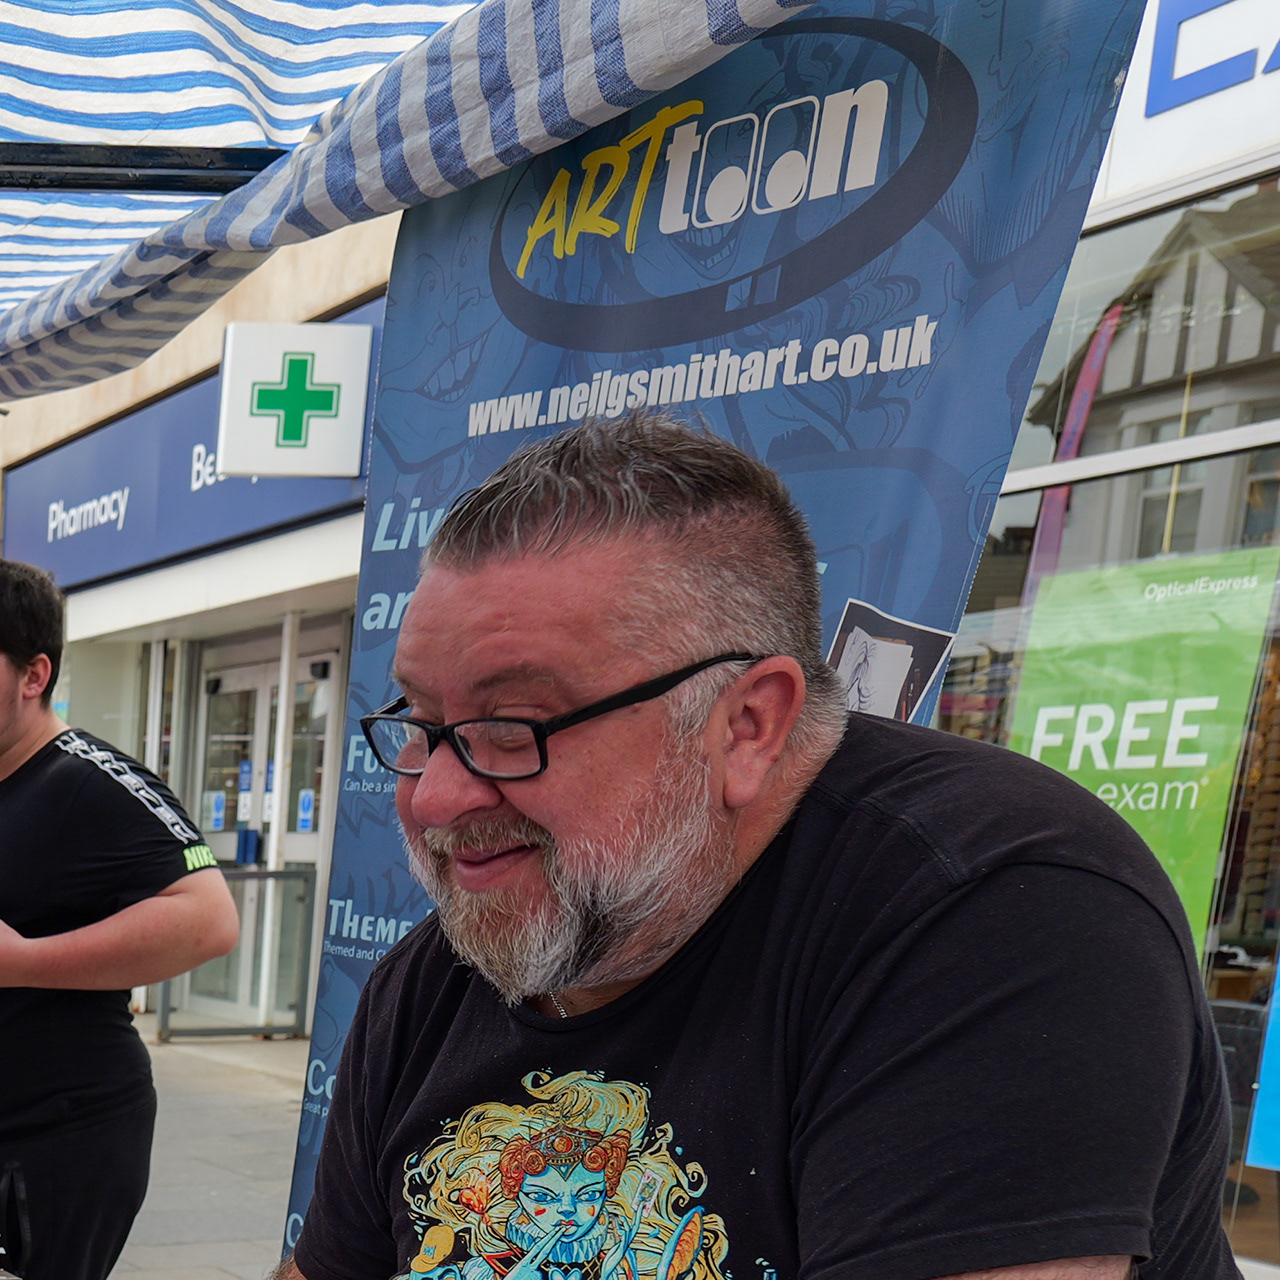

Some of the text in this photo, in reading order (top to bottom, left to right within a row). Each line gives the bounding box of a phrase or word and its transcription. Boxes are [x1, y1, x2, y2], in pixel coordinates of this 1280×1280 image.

[466, 314, 941, 438] www.neilgsmithart.co.uk
[47, 486, 130, 543] Pharmacy
[371, 497, 445, 552] Liv
[1030, 696, 1219, 772] FREE
[182, 844, 217, 872] NIKE
[355, 946, 375, 960] and
